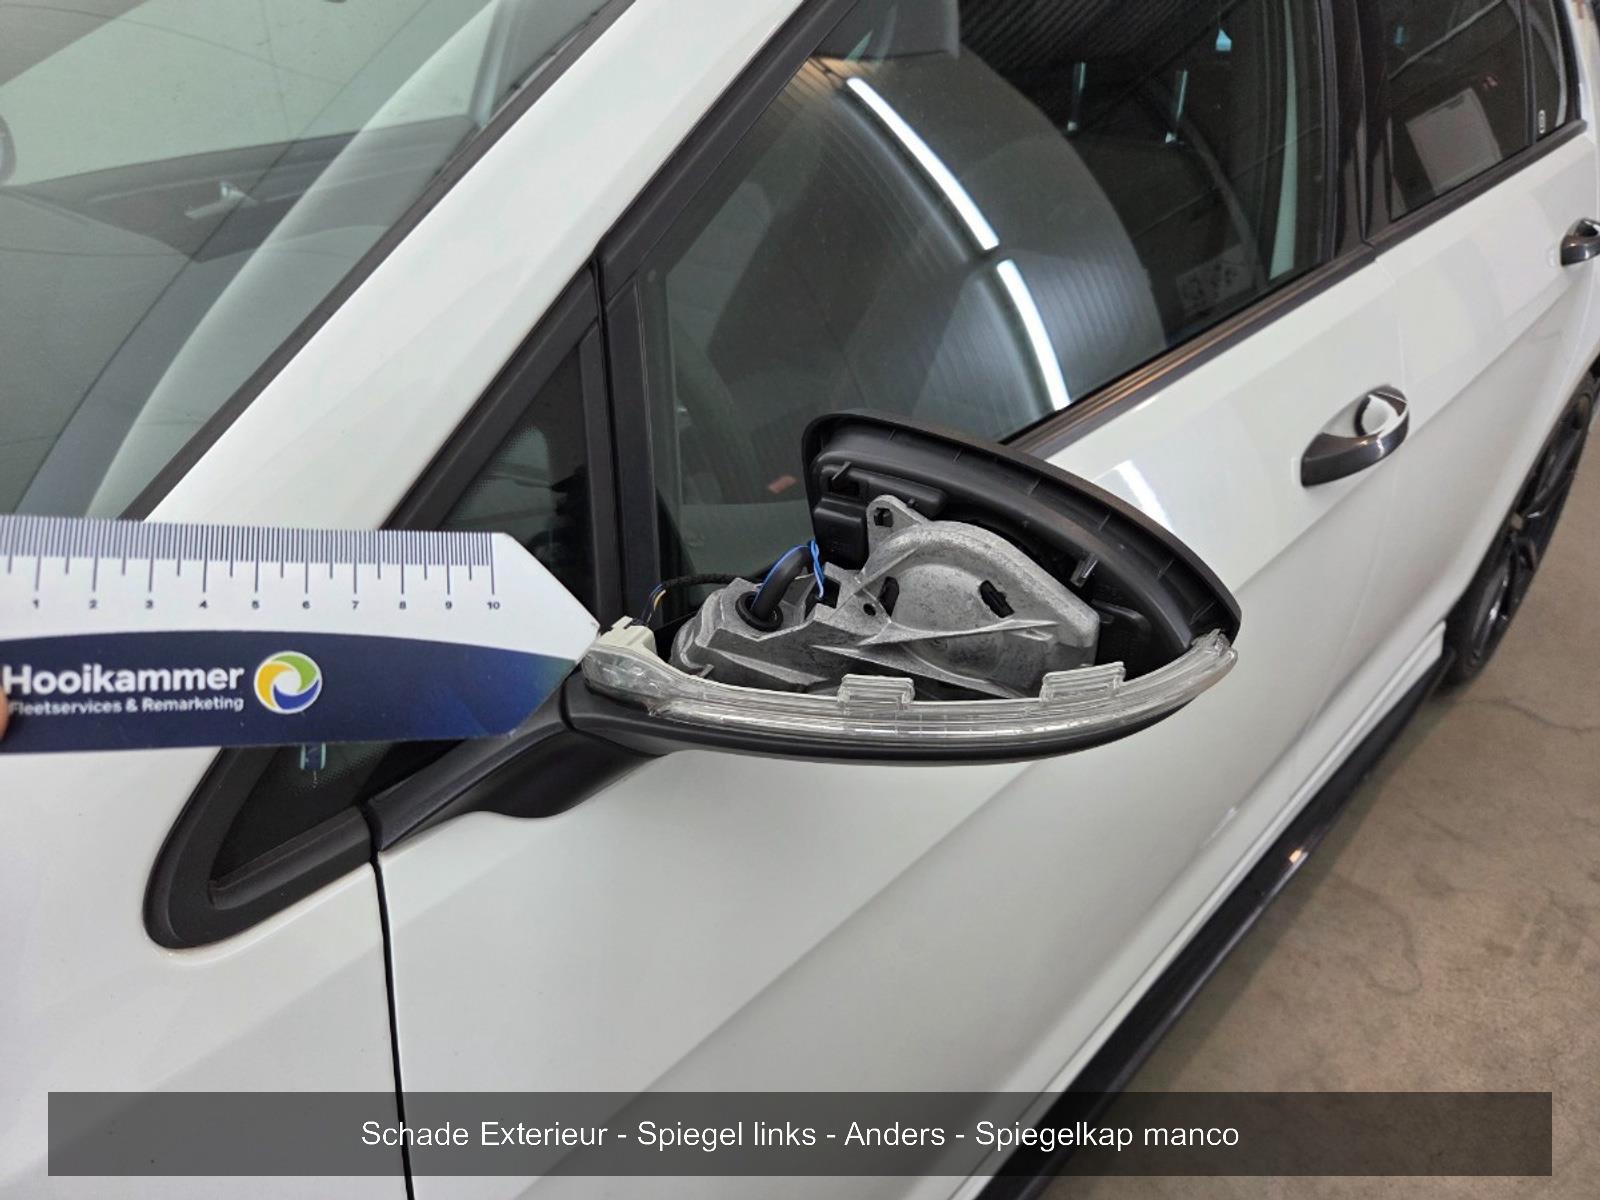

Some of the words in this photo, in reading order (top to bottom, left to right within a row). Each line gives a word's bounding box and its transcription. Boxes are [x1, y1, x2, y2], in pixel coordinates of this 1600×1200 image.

[32, 599, 39, 609] 1
[89, 599, 98, 609] 2
[145, 600, 154, 609] 3
[199, 600, 208, 609] 4
[302, 600, 311, 610] 6
[351, 600, 360, 610] 7
[399, 601, 407, 610] 8
[445, 601, 453, 610] 9
[487, 601, 500, 610] 10
[2, 663, 245, 695] Hooikammer
[125, 697, 138, 712] &
[142, 695, 244, 712] Remarketing
